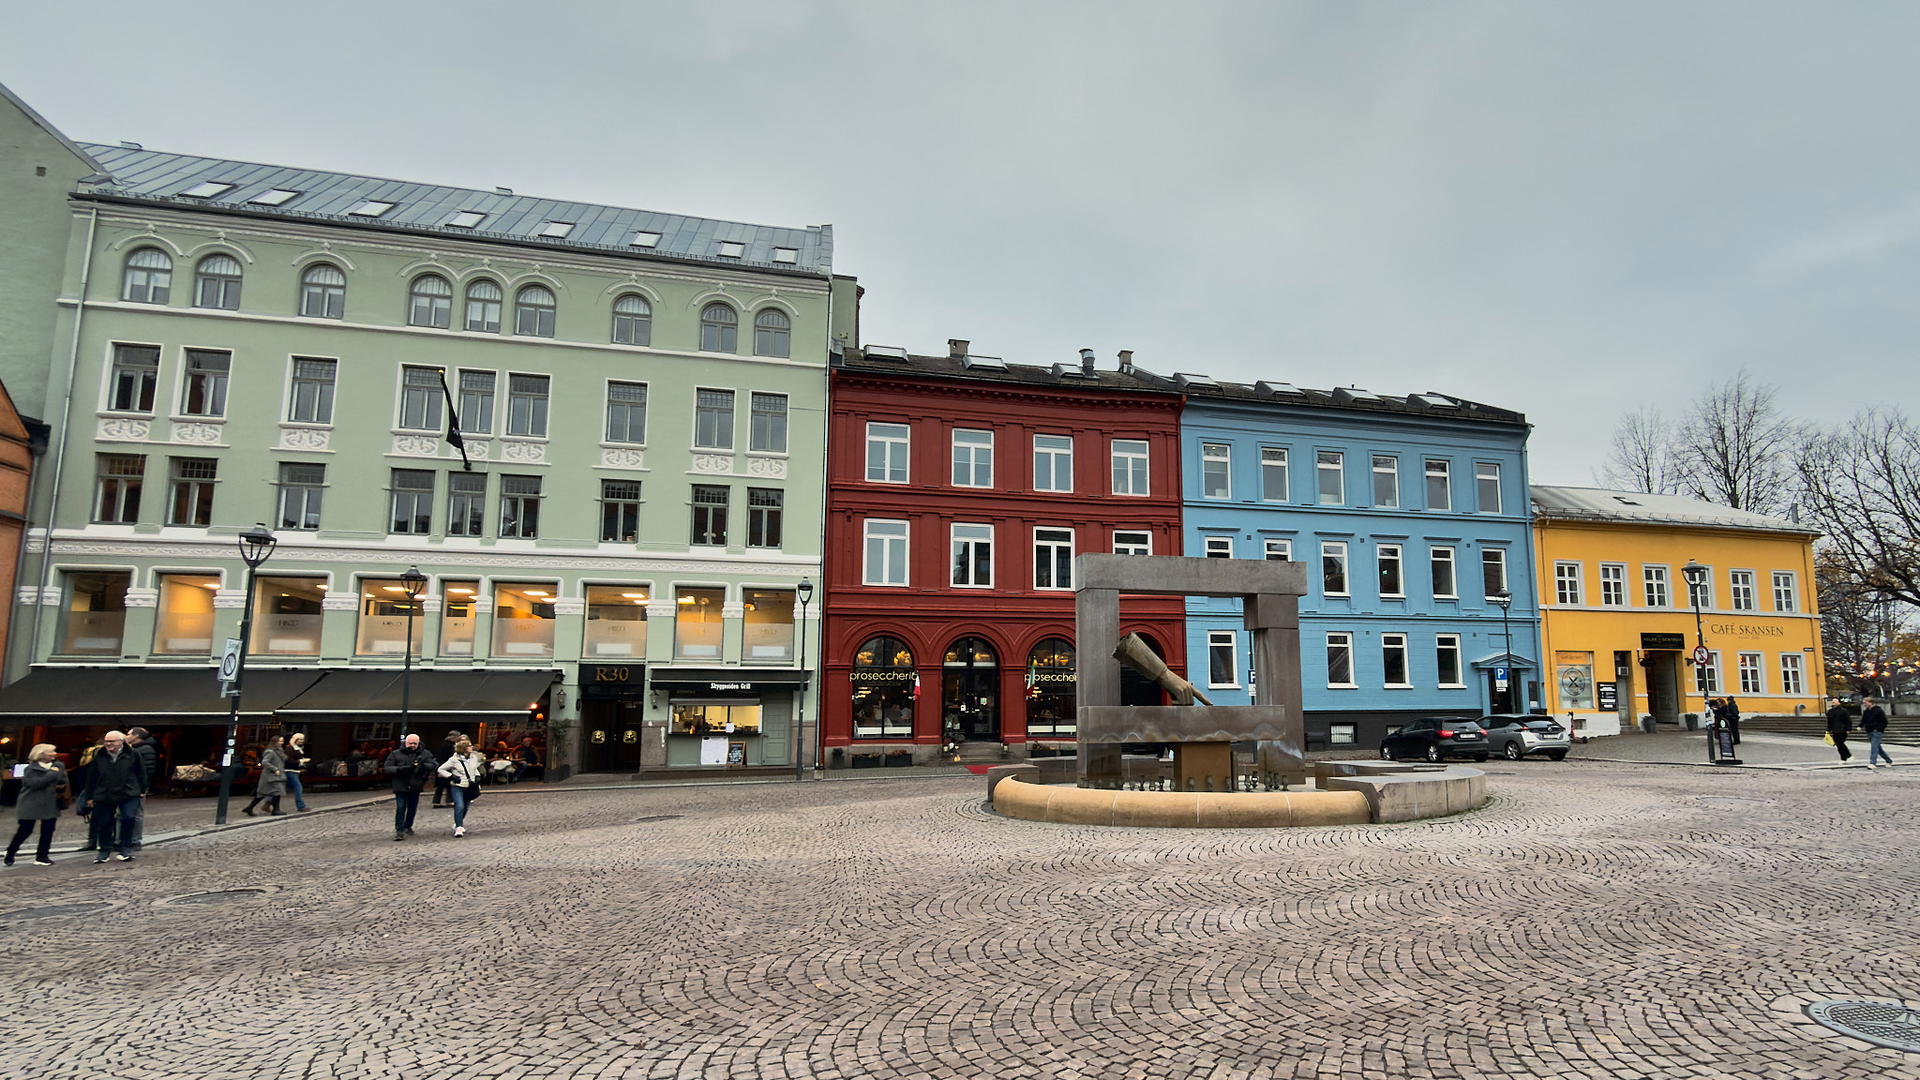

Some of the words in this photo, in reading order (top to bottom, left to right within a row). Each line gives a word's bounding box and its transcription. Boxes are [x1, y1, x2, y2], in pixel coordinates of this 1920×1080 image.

[1738, 625, 1784, 636] SKANSEN
[595, 667, 629, 681] R30
[1497, 668, 1505, 679] P
